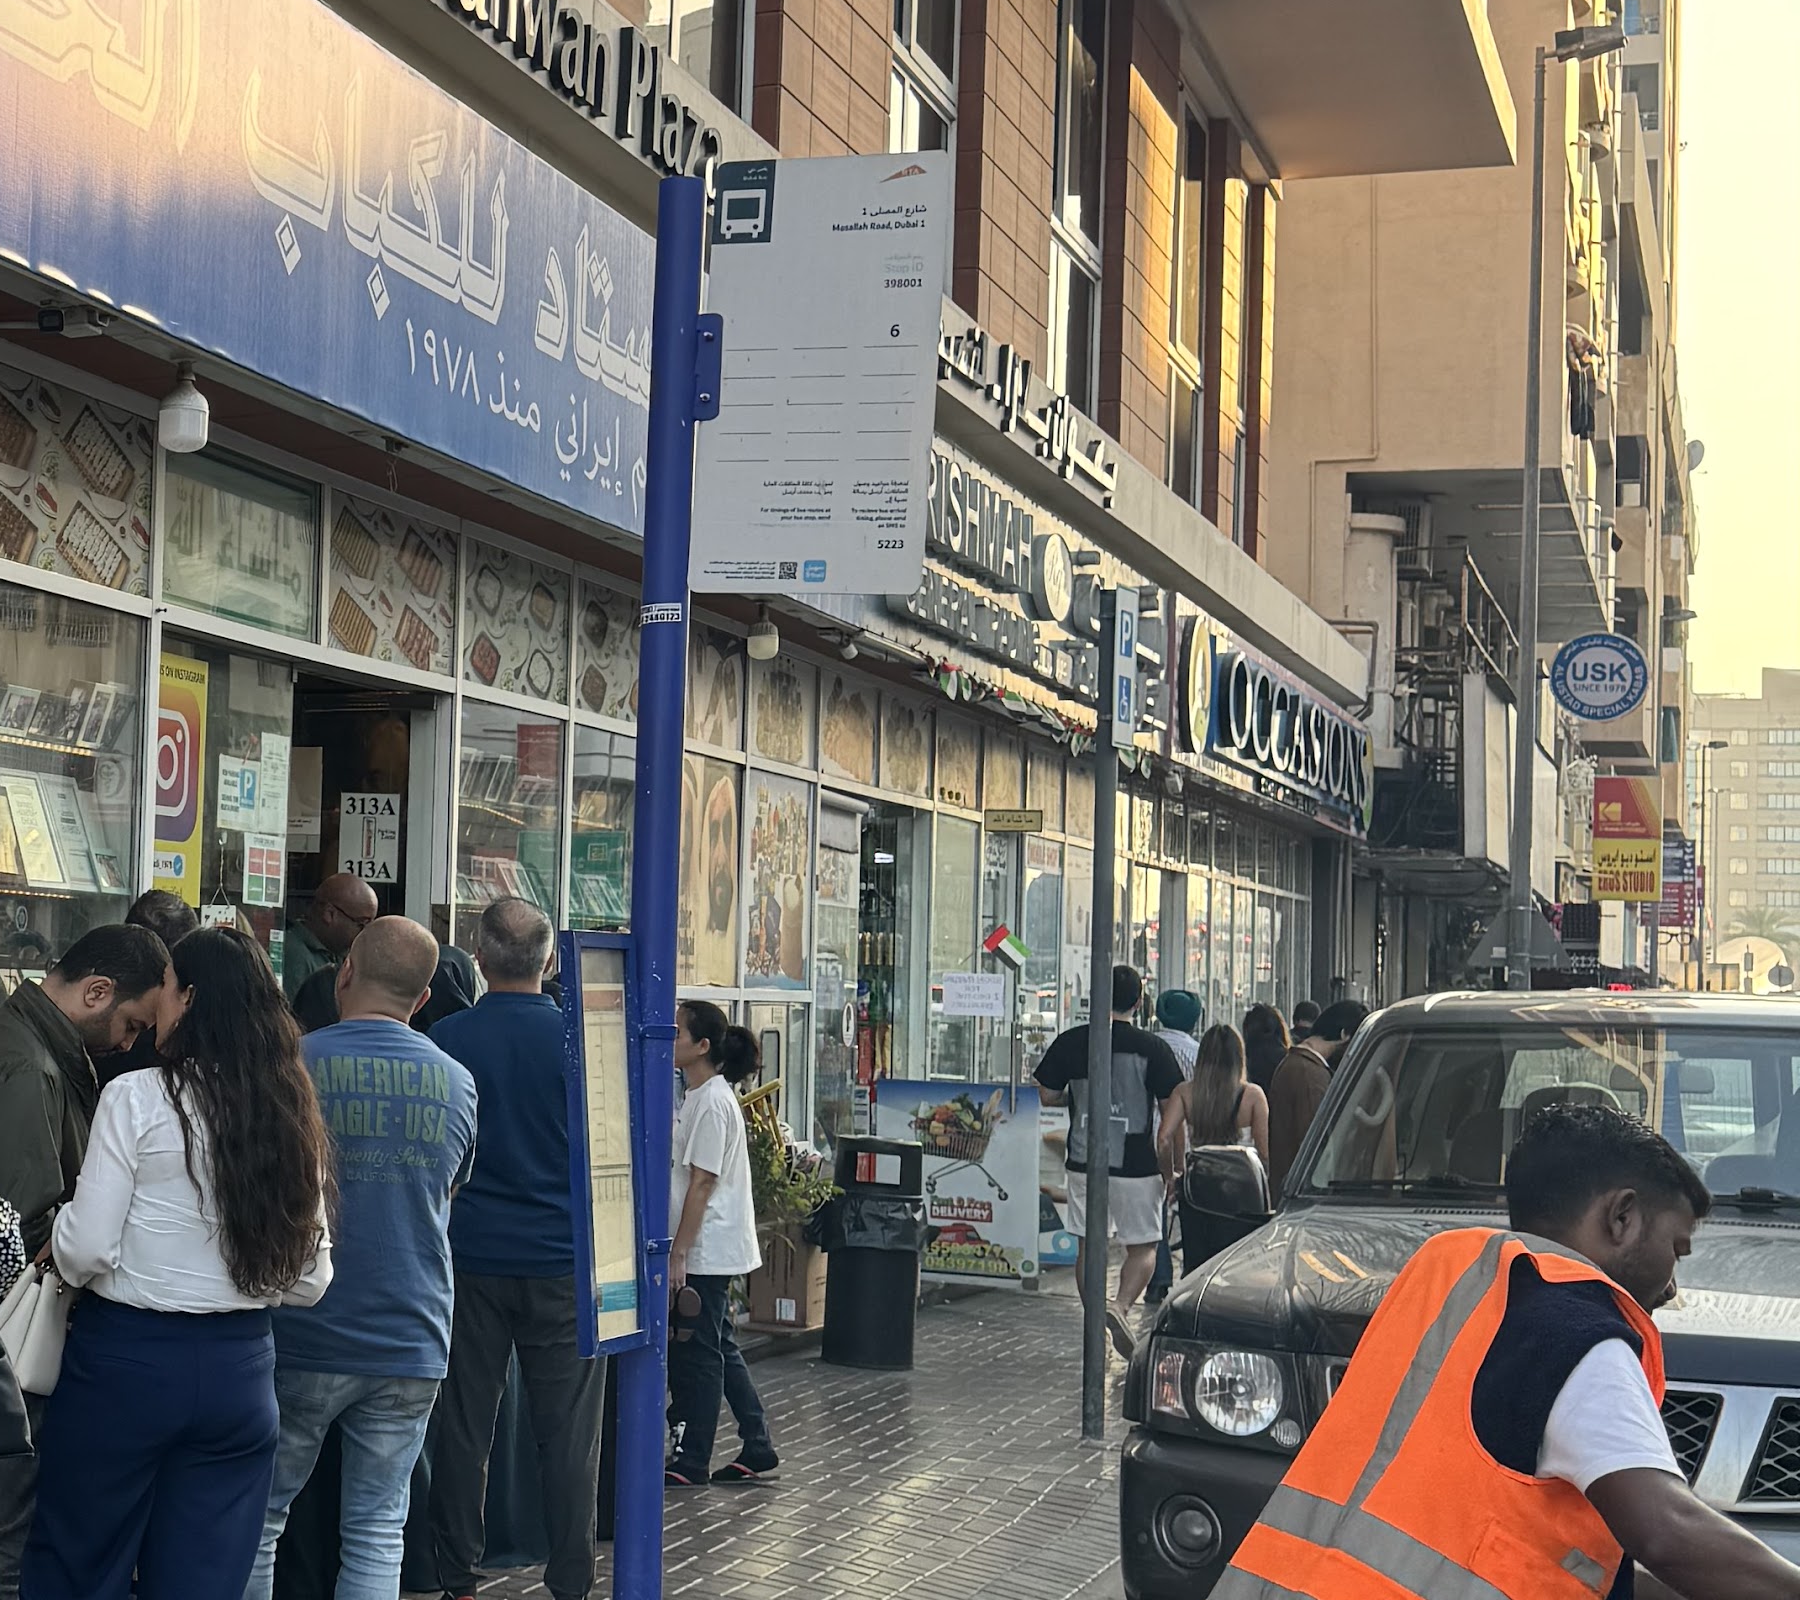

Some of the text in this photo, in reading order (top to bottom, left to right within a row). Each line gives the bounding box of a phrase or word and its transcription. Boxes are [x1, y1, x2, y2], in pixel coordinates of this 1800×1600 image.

[616, 26, 722, 200] Plaza
[242, 59, 509, 326] للكباب
[904, 204, 927, 217] شارع
[894, 219, 918, 229] Dubai
[884, 278, 922, 289] 398001
[890, 324, 900, 338] 6
[406, 318, 480, 405] ١٩٧٨
[490, 351, 541, 433] منذ
[555, 393, 623, 497] إيراني
[927, 450, 1033, 595] RISHMAH
[877, 539, 904, 549] 5223
[1121, 612, 1132, 654] P
[1572, 662, 1627, 682] USK
[1556, 681, 1581, 710] USTAD
[1581, 702, 1629, 717] SPECIAL
[1626, 665, 1644, 702] KABAB
[1573, 684, 1626, 693] SINCE 1978
[1220, 650, 1367, 810] OCCASIONS
[345, 796, 396, 816] 313A
[344, 859, 392, 880] 313A
[1598, 870, 1655, 892] EROS STUDIO
[314, 1055, 450, 1101] AMERICAN
[405, 1102, 447, 1144] USA
[339, 1149, 390, 1168] eventy
[931, 1206, 990, 1220] DELIVERY
